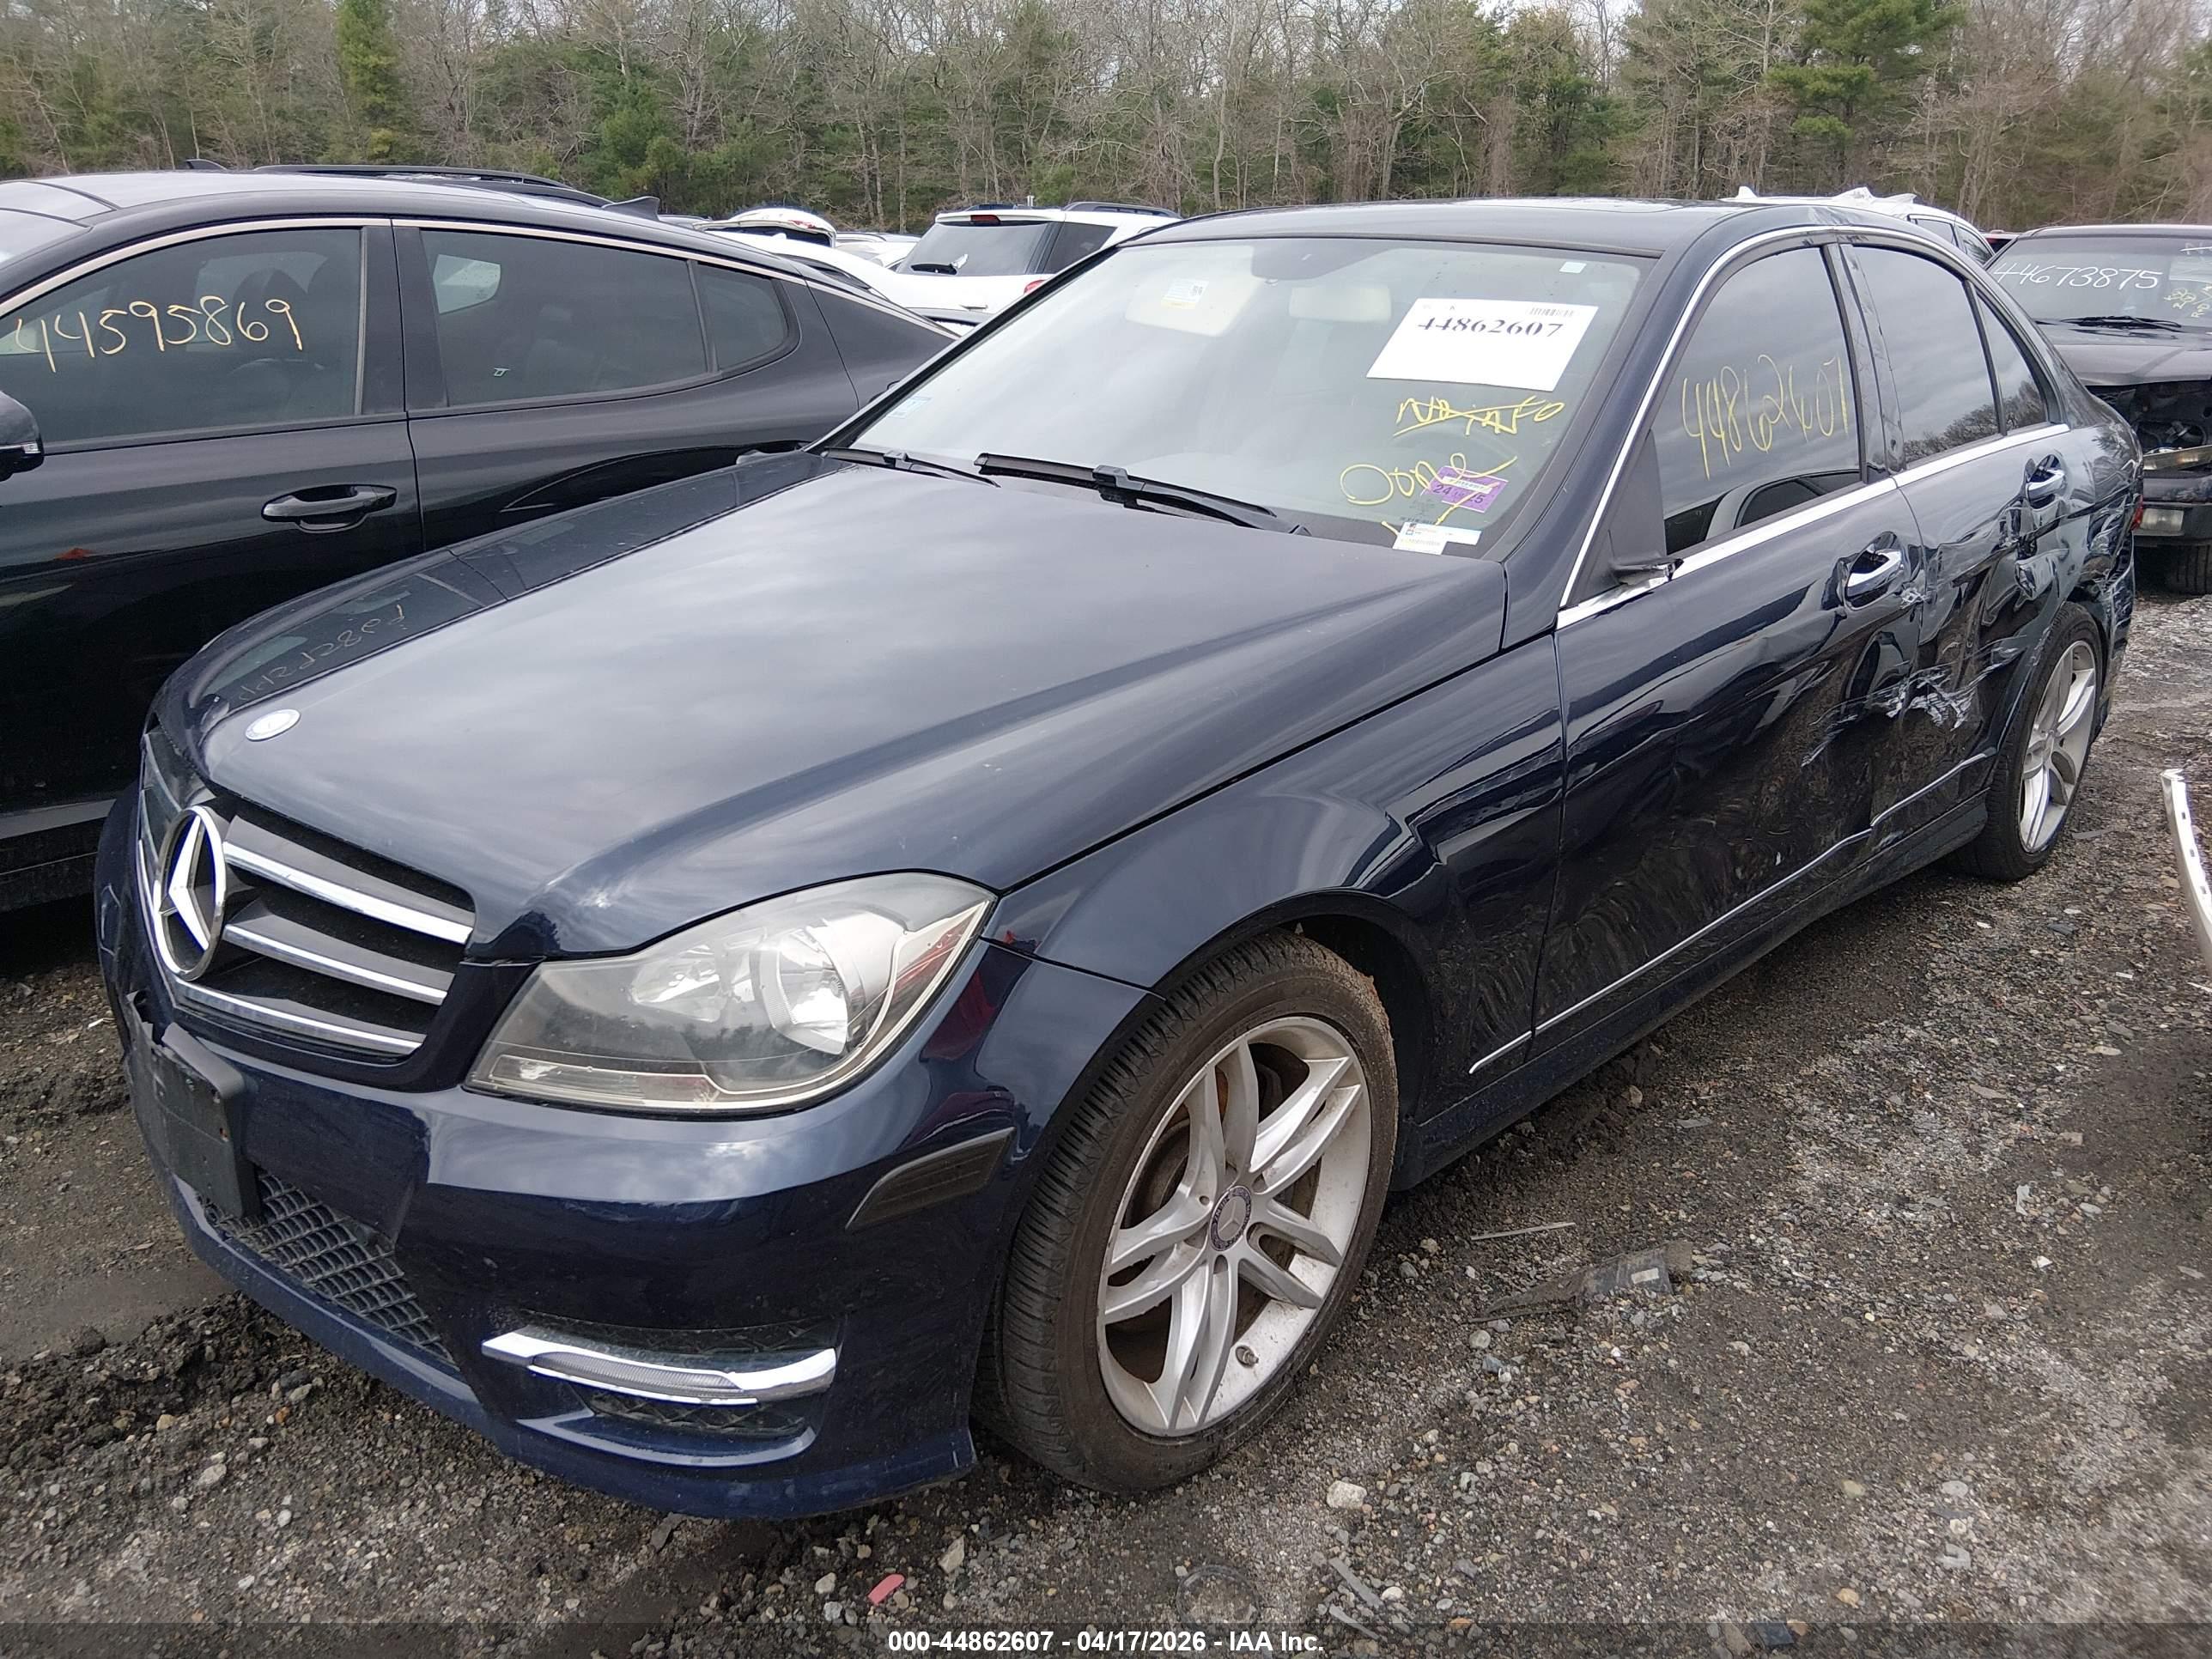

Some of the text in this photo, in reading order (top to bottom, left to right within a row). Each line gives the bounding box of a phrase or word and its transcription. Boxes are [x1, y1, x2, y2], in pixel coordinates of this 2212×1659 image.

[1994, 263, 2163, 290] 44673875
[15, 295, 304, 373] 44595869
[1418, 317, 1564, 337] 44862607
[1682, 355, 1848, 481] 44862607
[1433, 483, 1453, 496] 24
